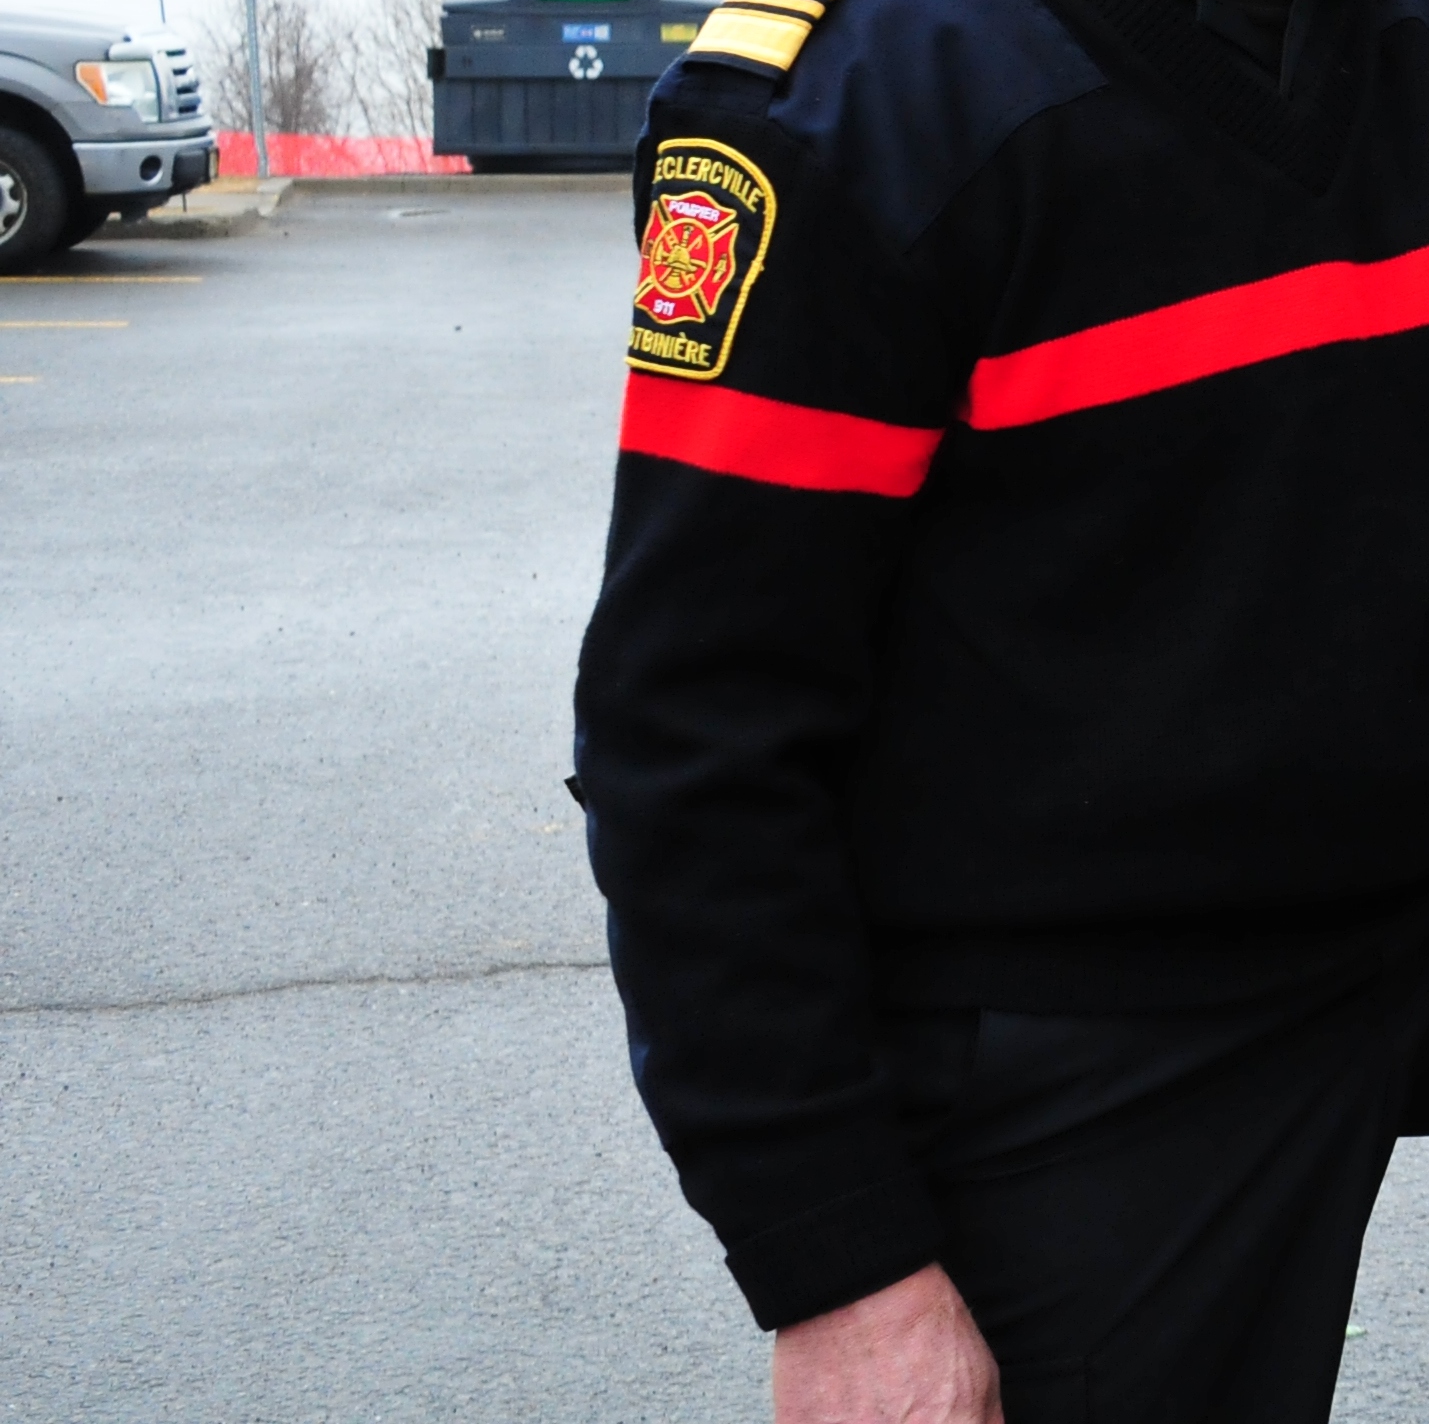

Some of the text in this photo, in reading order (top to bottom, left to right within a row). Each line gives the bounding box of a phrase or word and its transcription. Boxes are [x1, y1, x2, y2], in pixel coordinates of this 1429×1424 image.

[652, 156, 764, 213] ECLERCVILLE
[669, 201, 720, 222] POMPIER
[653, 299, 676, 317] 911
